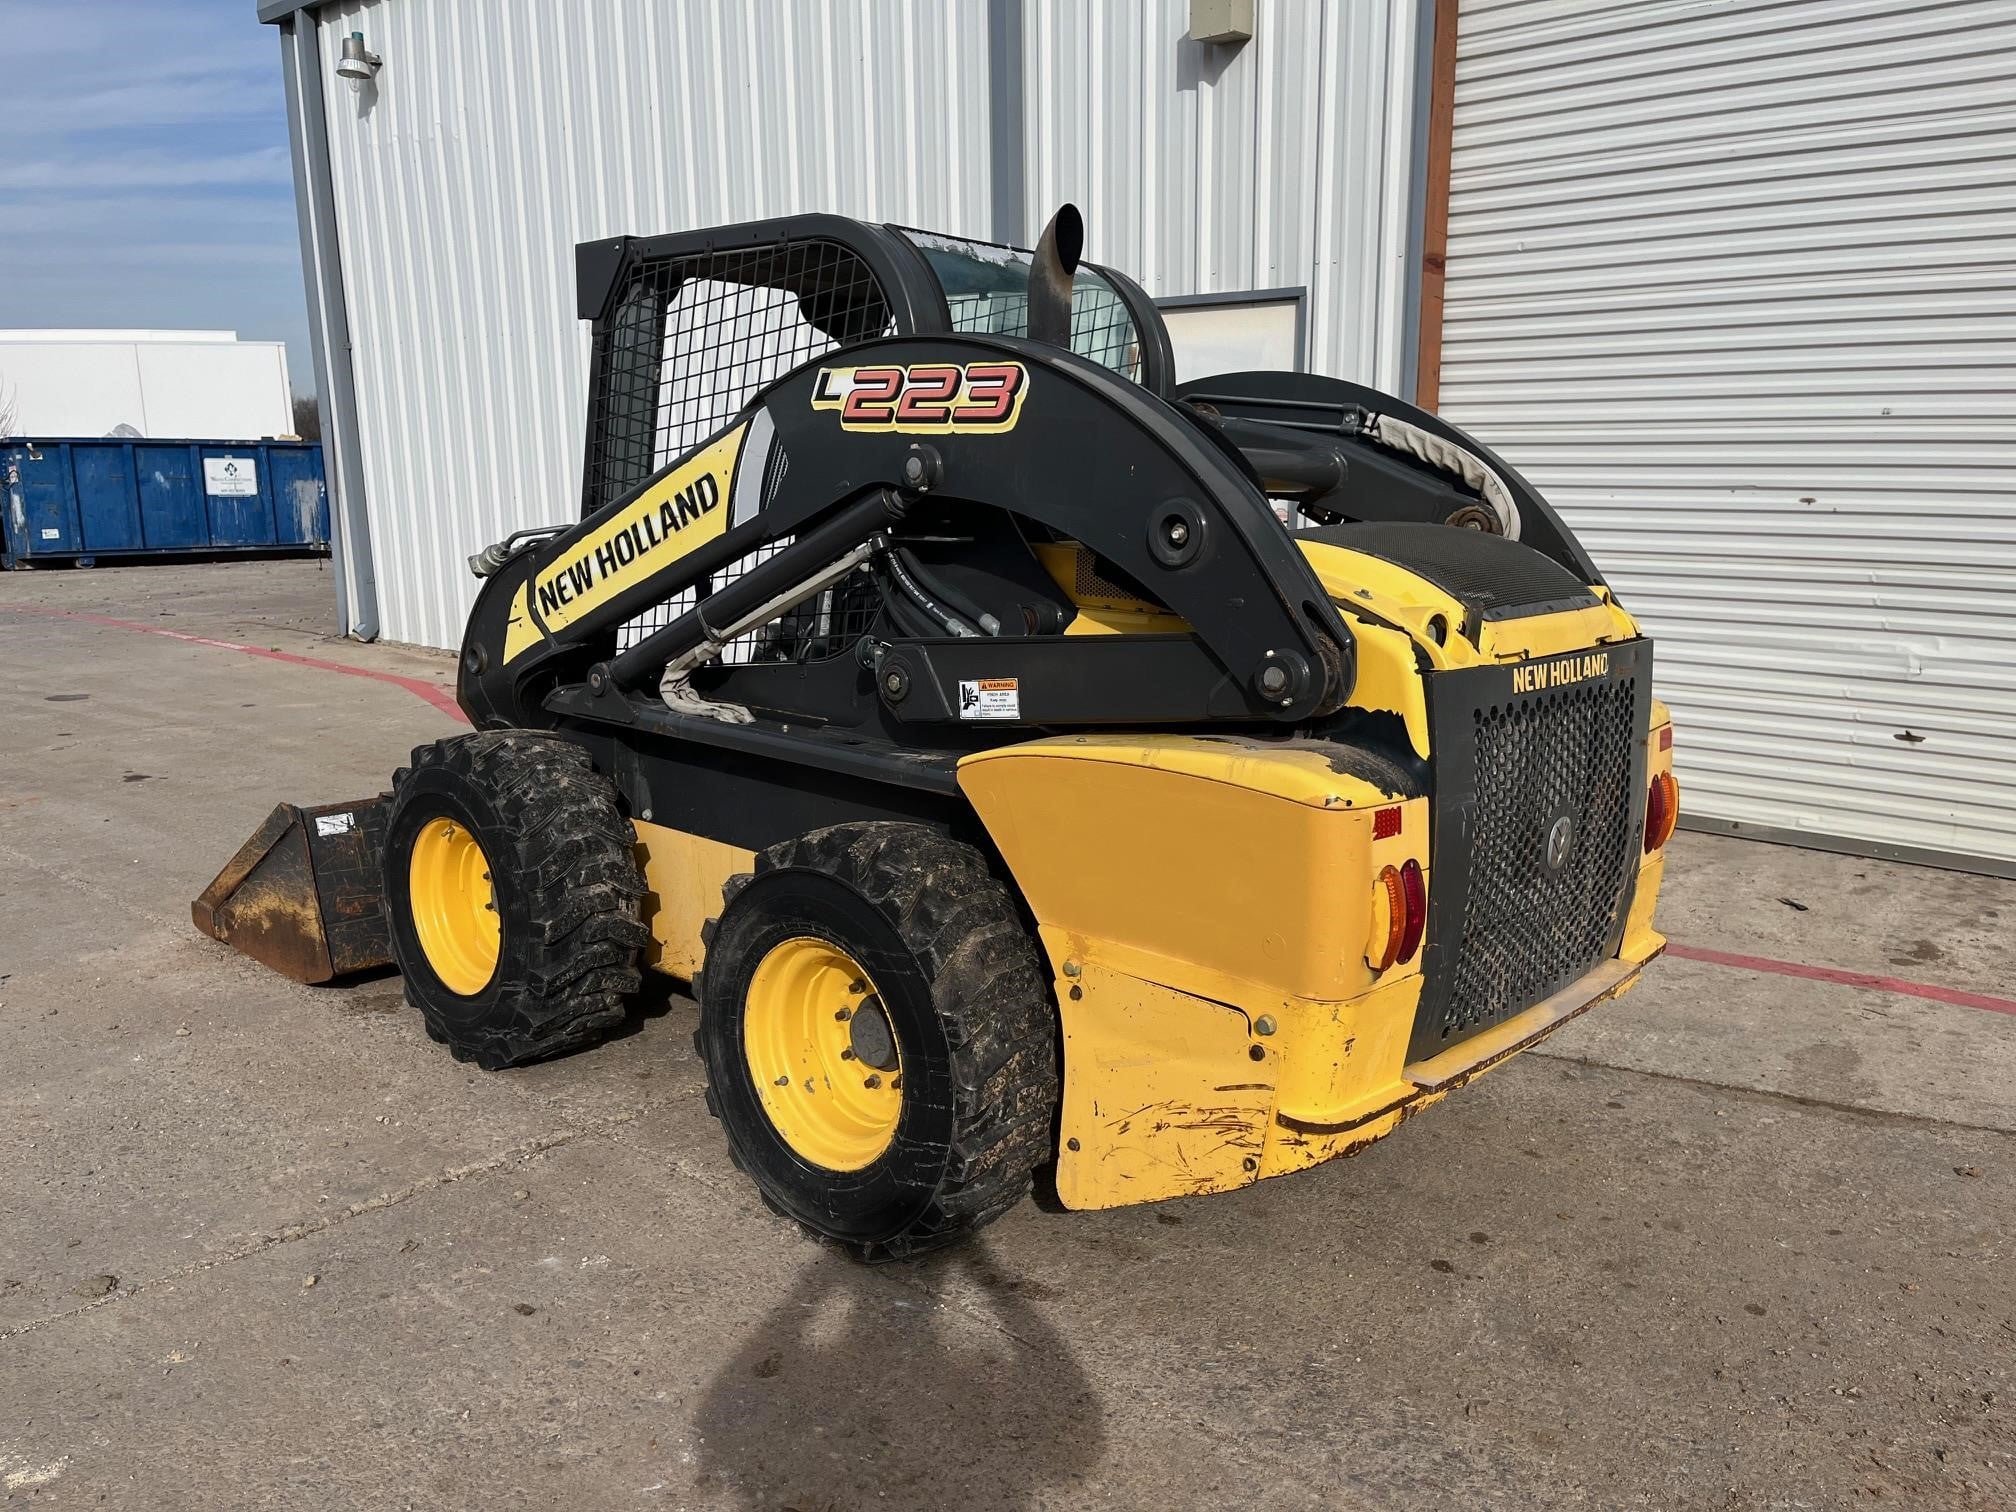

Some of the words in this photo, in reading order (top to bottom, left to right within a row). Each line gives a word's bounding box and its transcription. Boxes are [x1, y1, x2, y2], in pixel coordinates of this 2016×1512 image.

[813, 364, 1025, 425] L223
[538, 554, 593, 617] NEW
[594, 472, 719, 580] HOLLAND
[1513, 663, 1548, 694] NEW
[1550, 653, 1609, 687] HOLLAND
